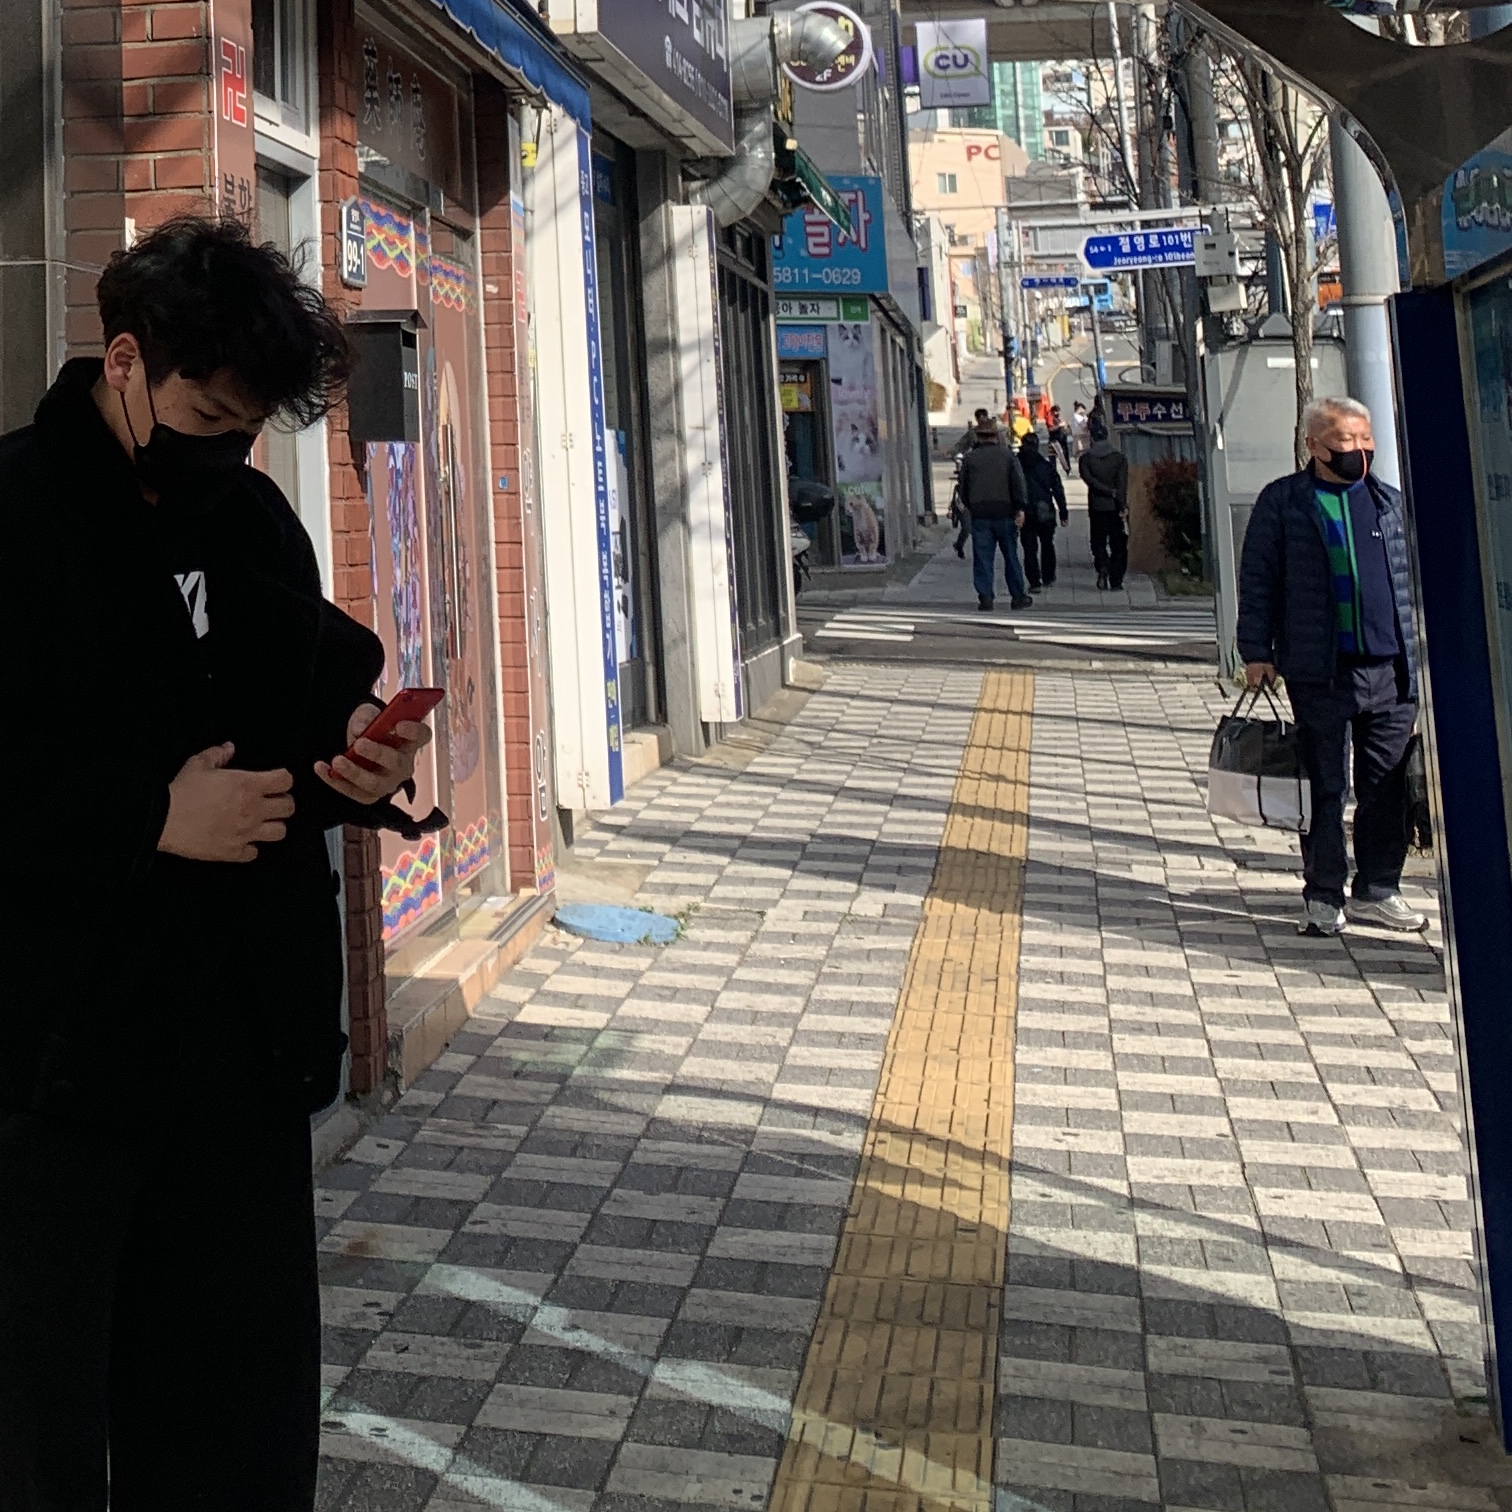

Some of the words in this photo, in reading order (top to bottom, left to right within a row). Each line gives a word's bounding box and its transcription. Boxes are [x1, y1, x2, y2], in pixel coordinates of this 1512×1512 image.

[934, 53, 968, 71] CU
[966, 144, 1000, 162] PC
[1118, 231, 1198, 253] 절영로101번
[347, 239, 364, 276] 99-1
[773, 267, 861, 285] 5811-0629
[403, 371, 418, 390] POST
